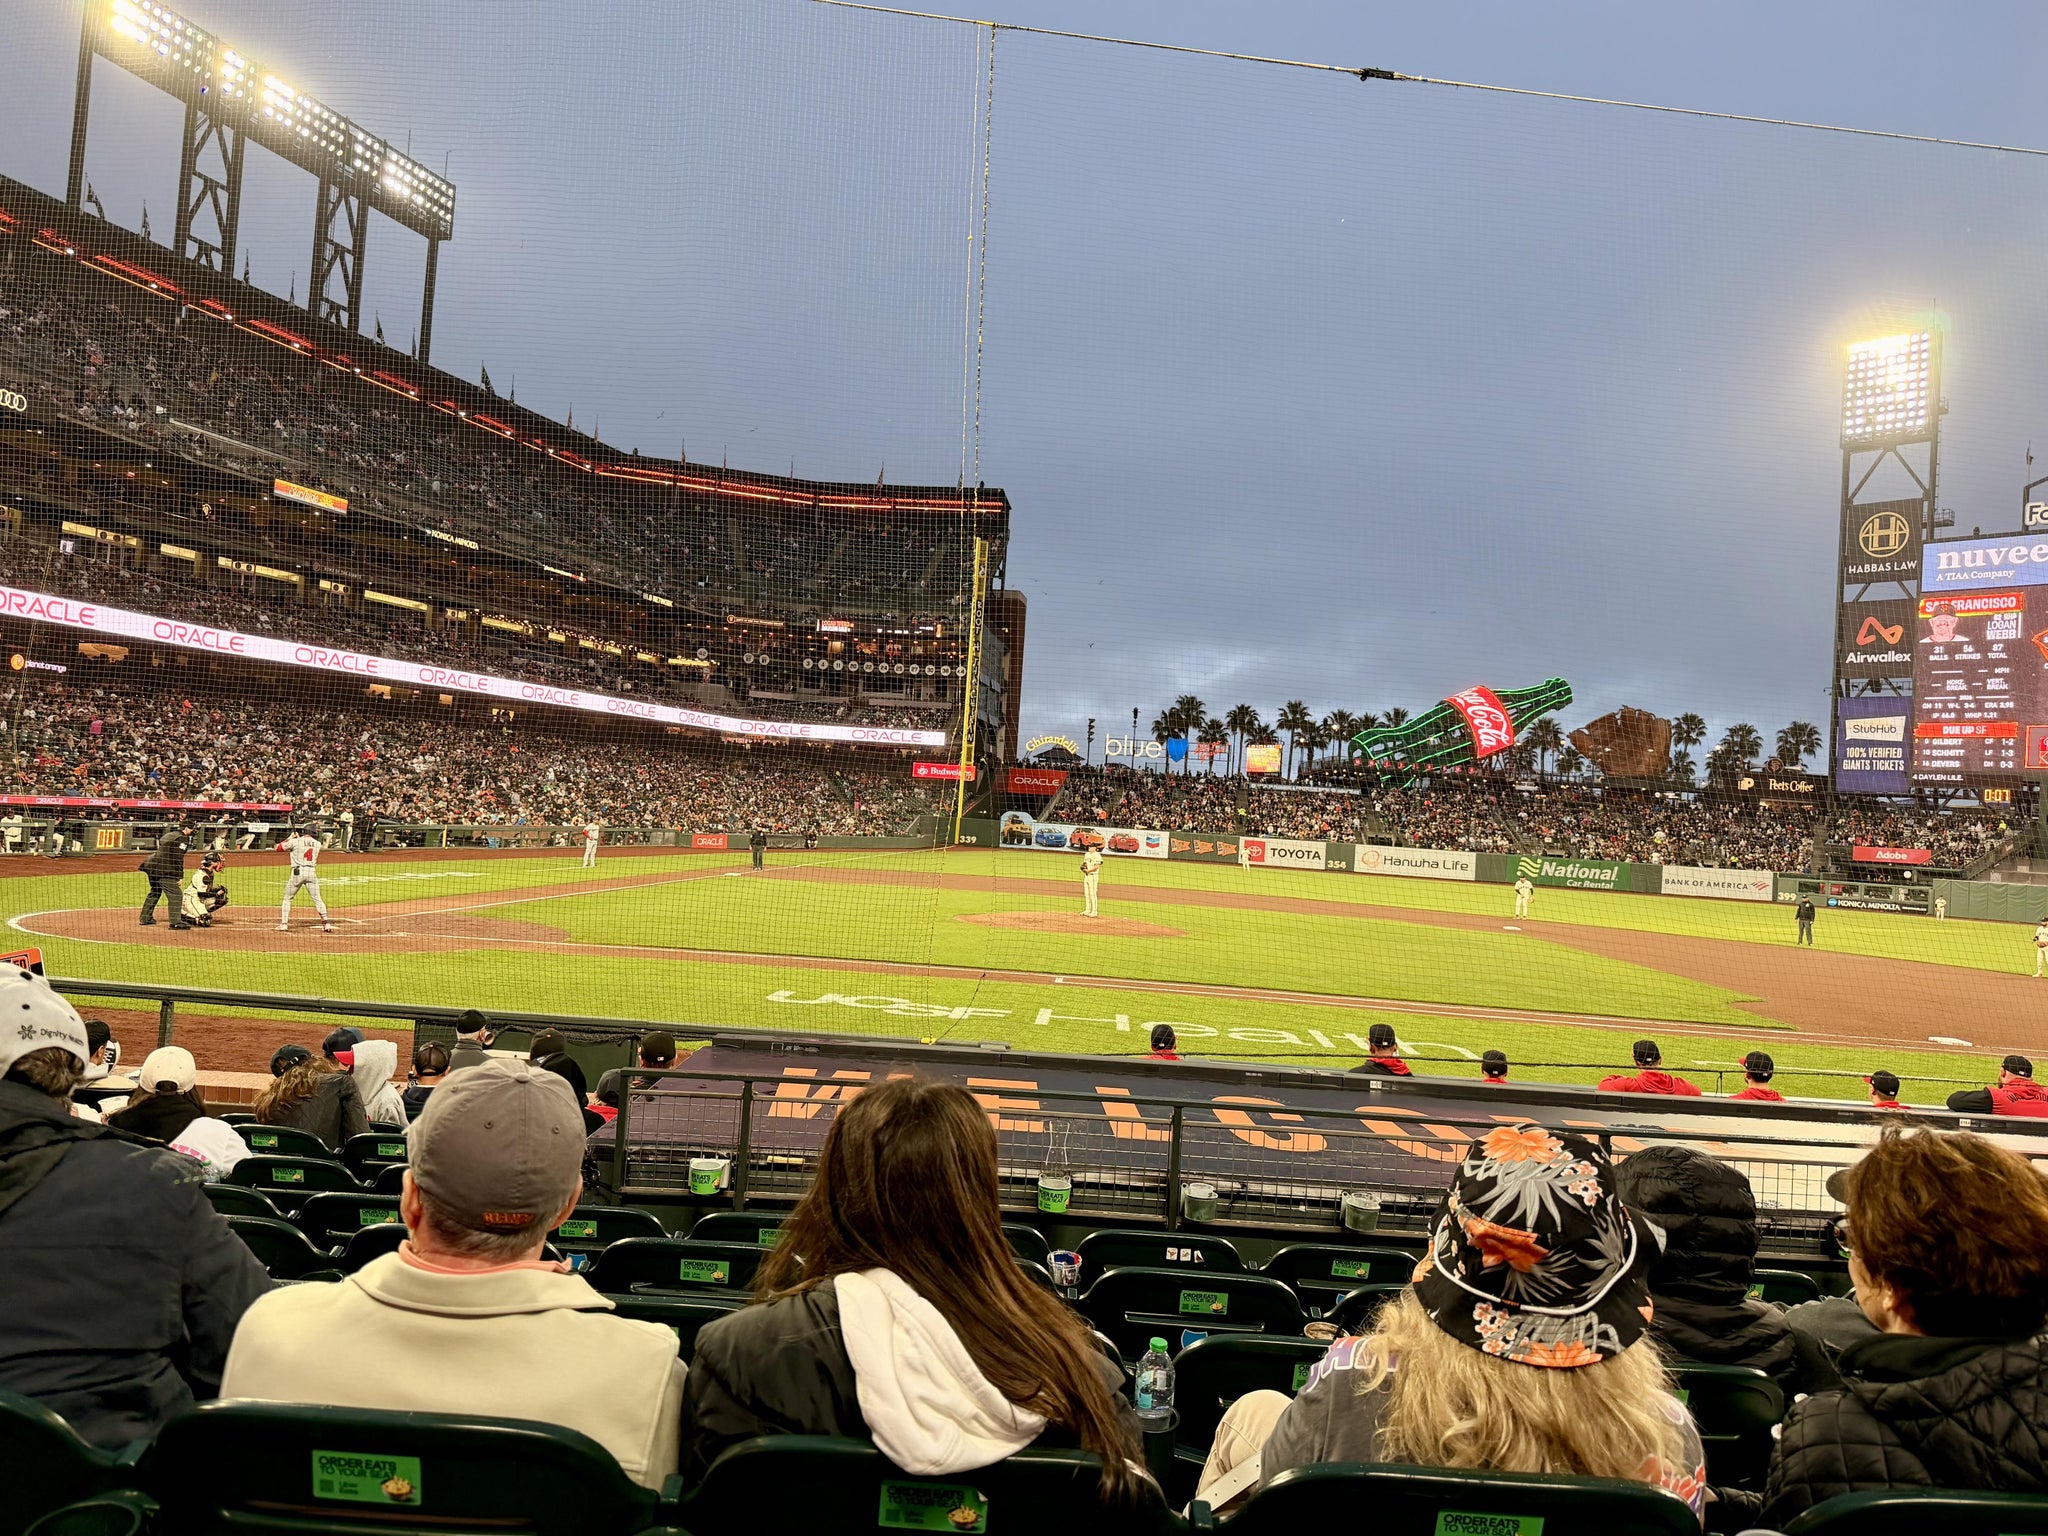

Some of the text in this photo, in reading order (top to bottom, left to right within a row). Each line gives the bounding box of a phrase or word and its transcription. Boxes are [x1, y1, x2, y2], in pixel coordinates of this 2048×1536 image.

[1848, 560, 1918, 574] HABBAS LAW
[1936, 569, 2015, 582] A TIAA Company
[1987, 620, 2017, 630] LOGAN
[153, 621, 245, 653] ORACLE
[1986, 630, 2017, 640] WEBB
[1933, 643, 2004, 654] 31 56 87
[295, 647, 379, 674] ORACLE
[1845, 650, 1912, 664] Airwallex
[25, 660, 67, 673] planet orange
[419, 668, 489, 691] ORACLE
[521, 685, 580, 706] ORACLE
[607, 699, 656, 718] ORACLE
[678, 711, 721, 728] ORACLE
[739, 721, 811, 737] ORACLE
[1852, 724, 1897, 734] StubHub
[1942, 725, 1987, 735] DUE UP SF
[851, 729, 922, 743] ORACLE
[1932, 738, 1963, 746] GILBERT
[2002, 738, 2014, 746] 1-2
[1026, 734, 1080, 755] Ghirardelli
[1105, 733, 1163, 758] blue
[1846, 747, 1903, 759] 100% VERIFIED
[1931, 749, 1965, 757] SCHMITT
[2001, 749, 2014, 757] 1-3
[1842, 759, 1905, 771] GIANTS TICKETS
[1931, 760, 1961, 768] DEVERS
[930, 766, 961, 777] Budwei
[1014, 776, 1060, 787] ORACLE
[1789, 780, 1814, 793] Coffee
[1984, 788, 2011, 802] 0:07
[696, 837, 724, 846] ORACLE
[959, 835, 977, 844] 339
[303, 848, 314, 862] 4
[1270, 847, 1322, 861] TOYOTA
[1875, 850, 1908, 860] Adobe
[1327, 859, 1347, 869] 354
[1383, 855, 1469, 872] Hanwha Life
[1541, 861, 1618, 881] National
[1566, 879, 1614, 889] Car Rental
[1664, 878, 1749, 890] BANK OF AMERICA
[1777, 891, 1797, 902] 399
[1837, 899, 1866, 909] KONICA
[1867, 901, 1901, 911] MINOLTA
[765, 989, 1012, 1021] UCSF
[40, 1028, 68, 1040] Dignity
[683, 1260, 704, 1268] ORDER
[1182, 1292, 1218, 1301] ORDER EATS
[318, 1455, 397, 1473] ORDER EATS
[320, 1465, 336, 1475] TO
[338, 1467, 367, 1478] YOUR
[887, 1485, 932, 1499] ORDER
[1443, 1513, 1520, 1529] ORDER EATS
[1443, 1523, 1458, 1533] TO
[1461, 1524, 1490, 1535] YOUR
